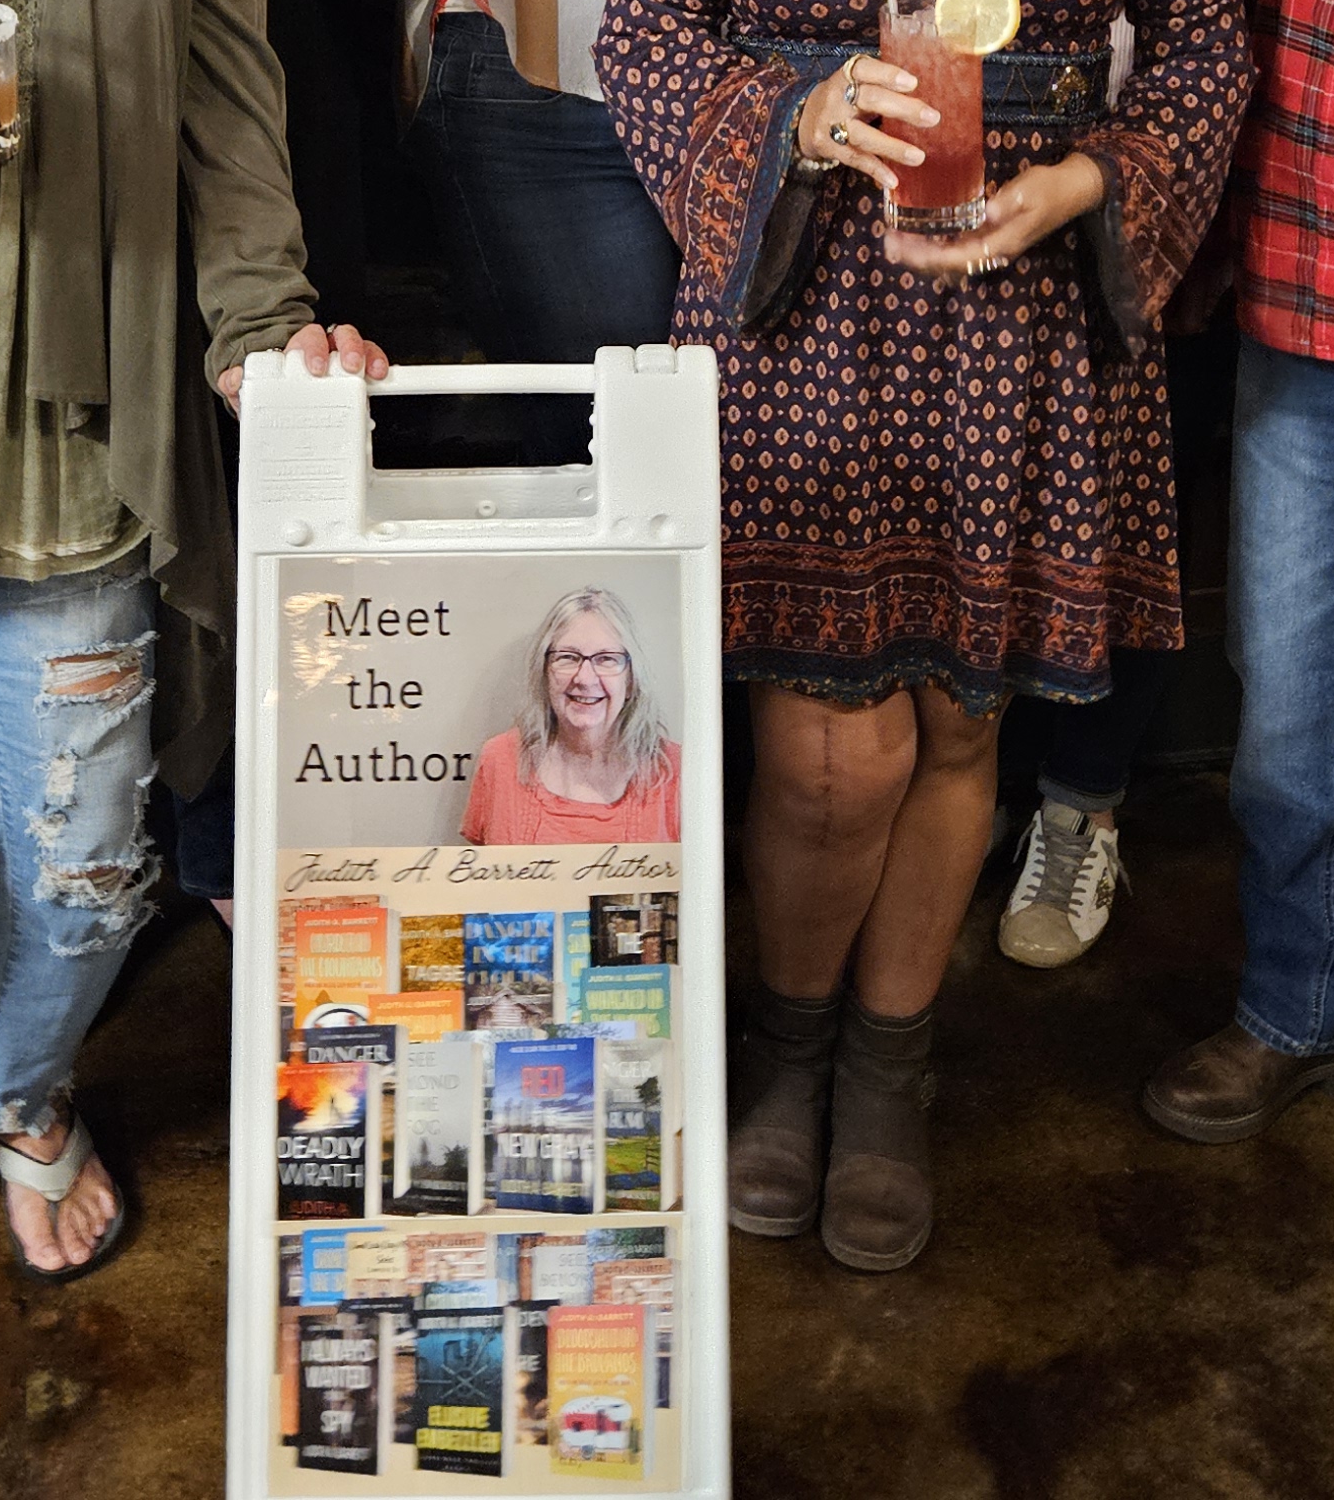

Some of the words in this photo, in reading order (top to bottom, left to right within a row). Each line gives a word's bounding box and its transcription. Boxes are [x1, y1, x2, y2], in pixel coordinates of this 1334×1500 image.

[324, 597, 451, 637] Meet
[347, 668, 423, 710] the
[295, 740, 473, 783] Author
[285, 853, 378, 893] Judith
[572, 845, 680, 884] Author
[308, 1045, 393, 1064] DANGER
[277, 1136, 365, 1160] DEADLY
[278, 1163, 365, 1188] WRATH
